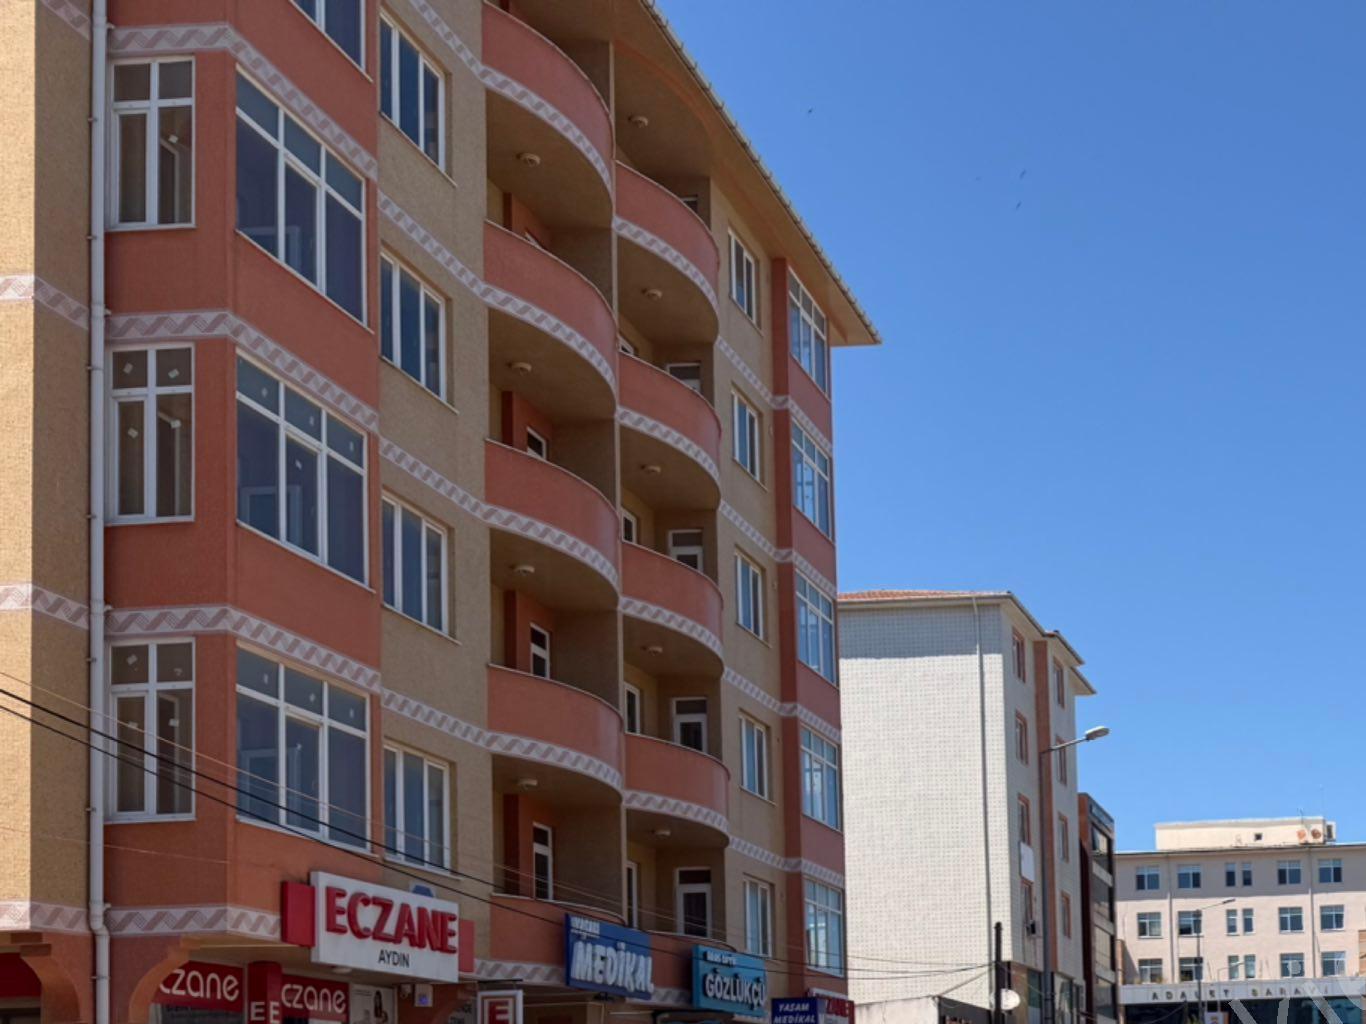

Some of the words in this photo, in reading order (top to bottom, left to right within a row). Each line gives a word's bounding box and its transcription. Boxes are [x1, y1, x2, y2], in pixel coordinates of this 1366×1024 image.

[326, 886, 457, 954] ECZANE
[378, 949, 410, 968] AYDIN
[571, 941, 654, 993] MEDİKAL
[282, 983, 346, 1014] czane
[705, 969, 765, 1009] GÖZLÜKÇÜ
[1153, 988, 1230, 1001] ADALET
